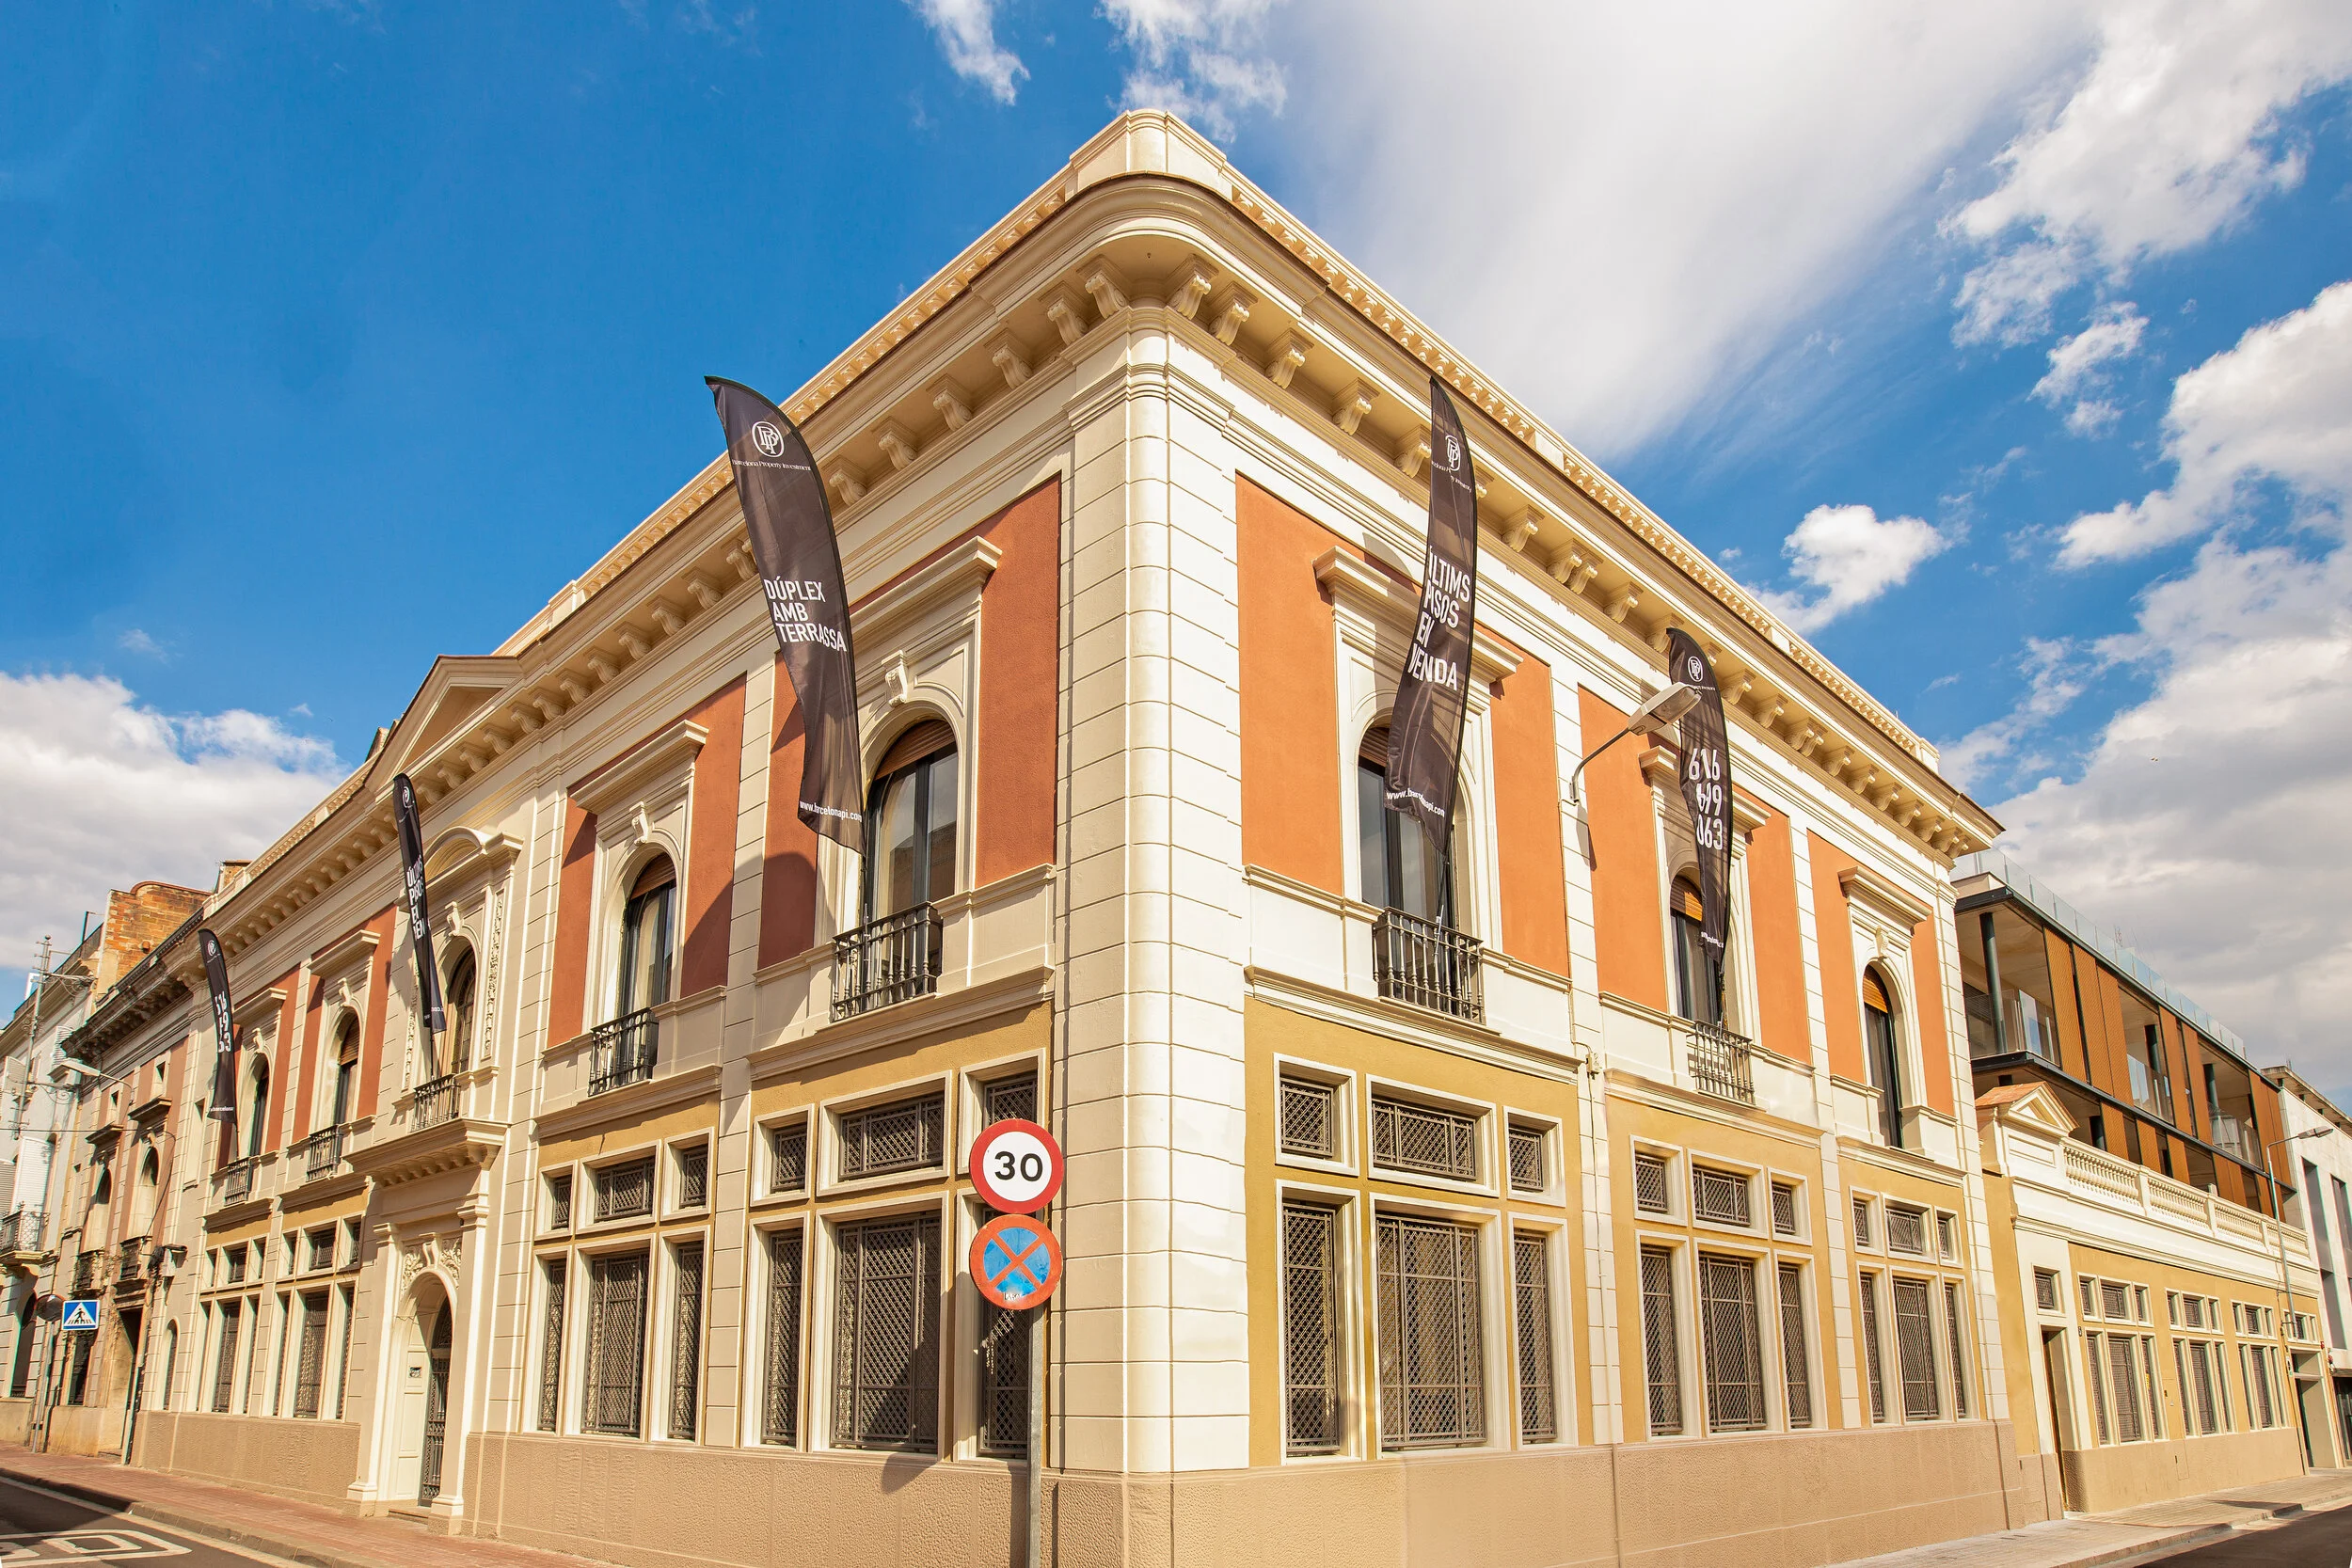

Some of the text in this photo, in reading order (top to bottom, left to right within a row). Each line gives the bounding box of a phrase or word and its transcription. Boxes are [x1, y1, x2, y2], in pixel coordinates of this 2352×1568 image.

[763, 576, 826, 602] DÚPLEX
[772, 602, 808, 622] AMB
[775, 623, 847, 652] TERRASSA
[1689, 748, 1721, 781] 616
[994, 1150, 1043, 1182] 30
